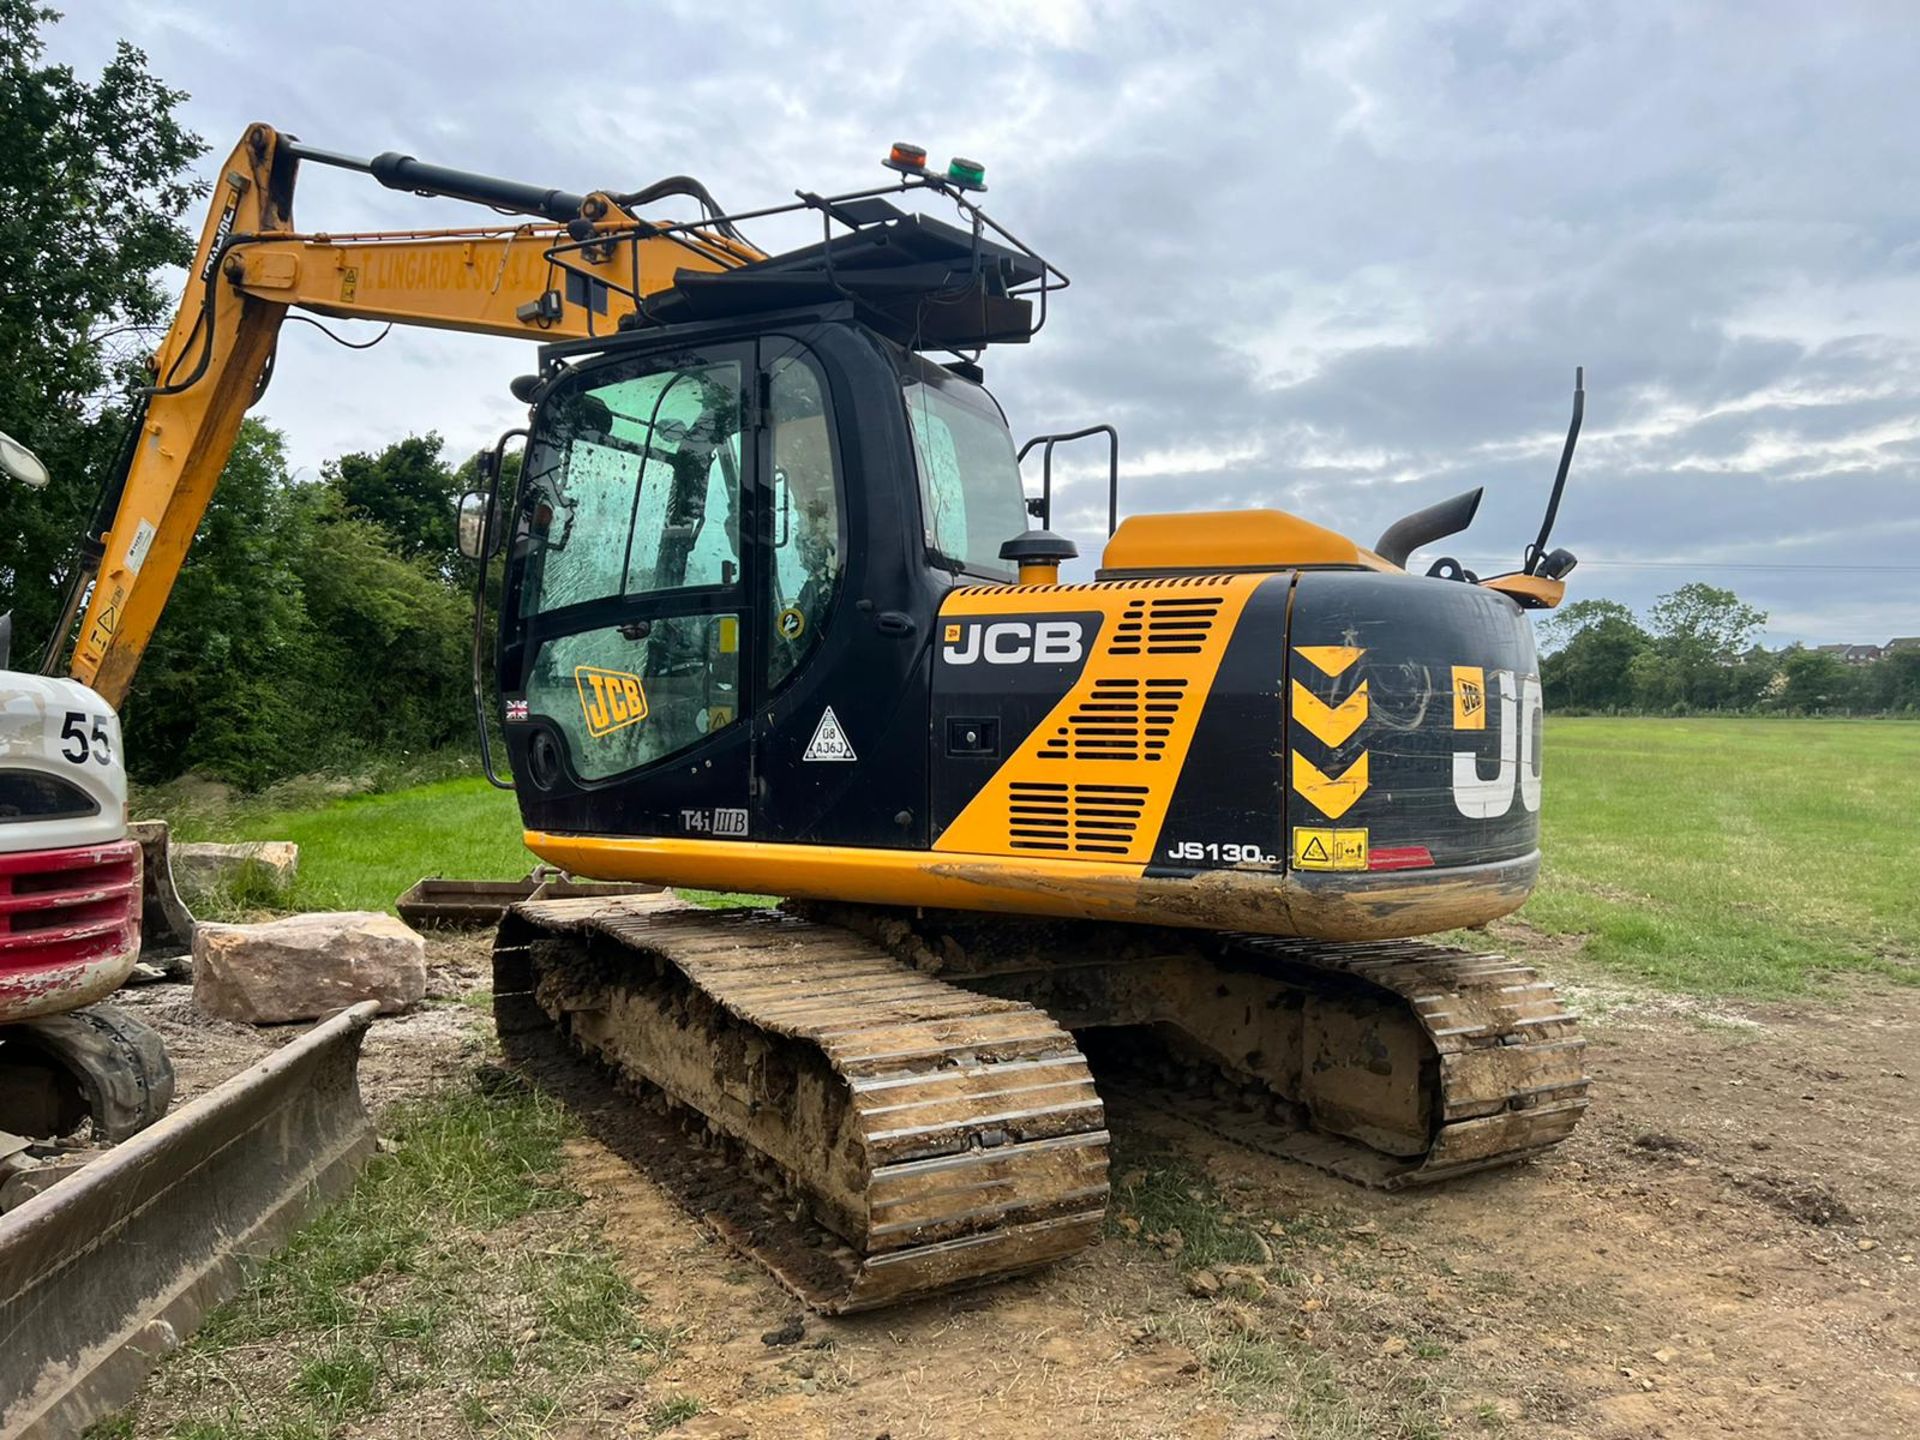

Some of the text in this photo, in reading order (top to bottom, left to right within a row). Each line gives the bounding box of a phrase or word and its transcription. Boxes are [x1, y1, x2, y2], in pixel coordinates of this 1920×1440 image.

[377, 250, 451, 289] LINGARD
[943, 622, 1083, 665] JCB
[588, 674, 643, 729] JCB
[61, 711, 111, 766] 55
[822, 728, 836, 740] 08
[681, 810, 711, 832] T4i
